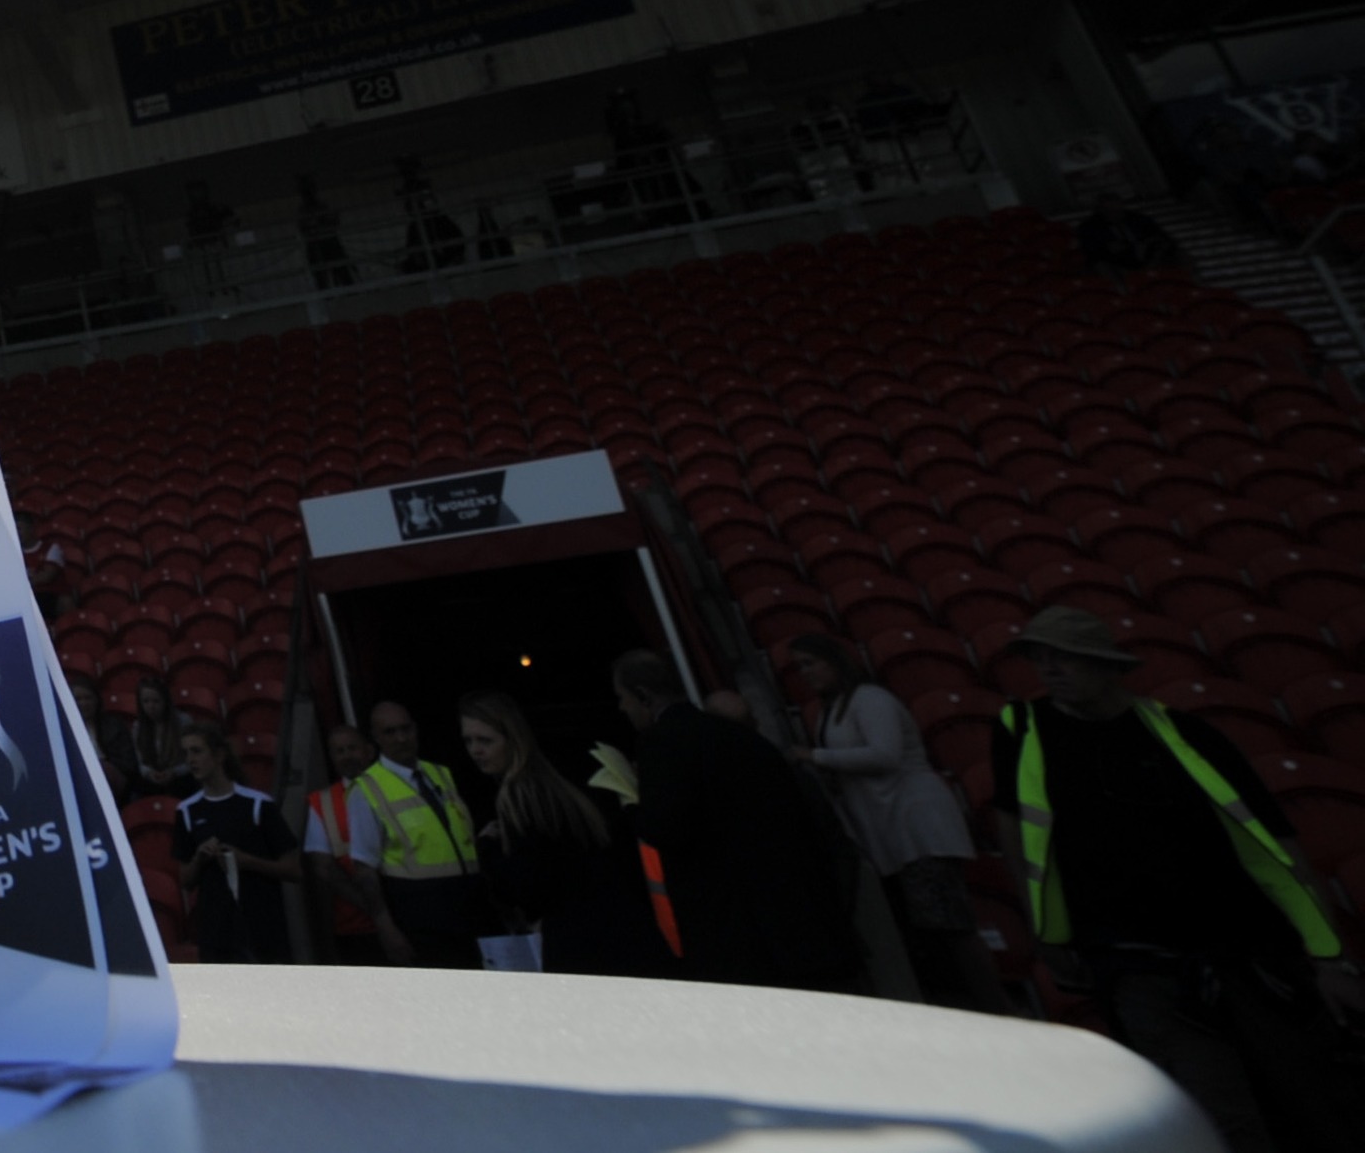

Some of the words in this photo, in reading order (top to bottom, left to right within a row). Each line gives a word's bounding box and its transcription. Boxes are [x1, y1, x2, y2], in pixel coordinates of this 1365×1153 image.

[356, 76, 393, 104] 28
[436, 493, 498, 513] WOMEN'S
[457, 508, 481, 520] CUP
